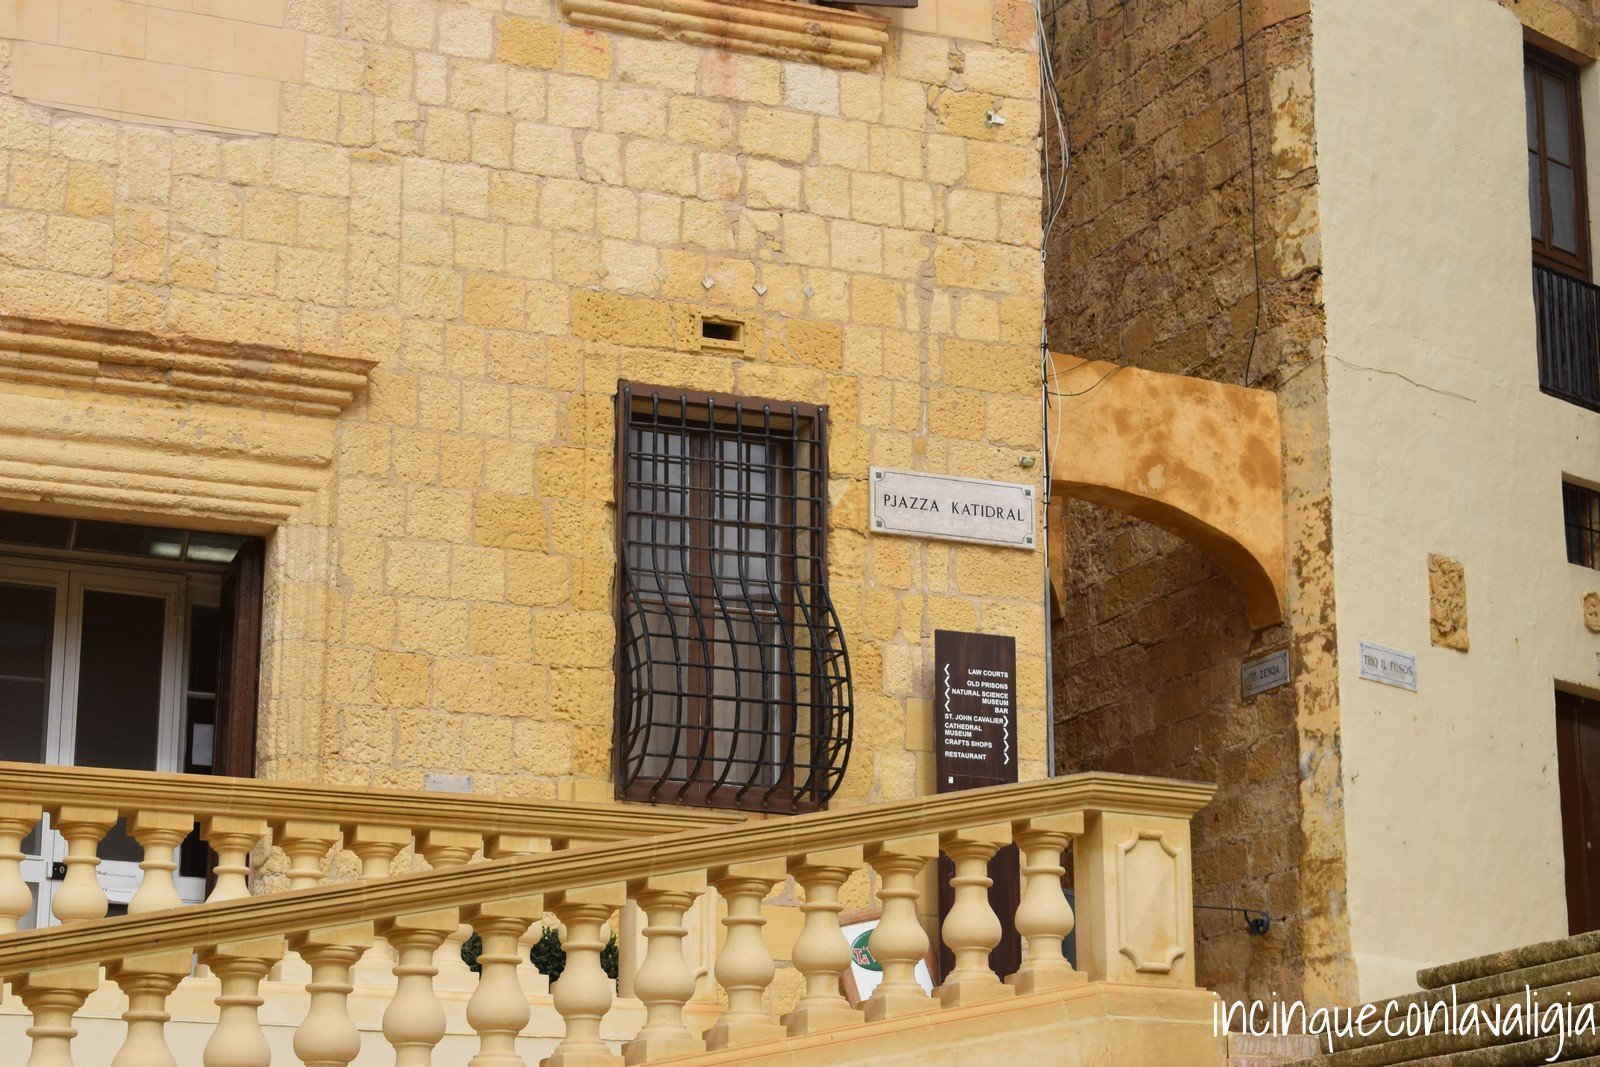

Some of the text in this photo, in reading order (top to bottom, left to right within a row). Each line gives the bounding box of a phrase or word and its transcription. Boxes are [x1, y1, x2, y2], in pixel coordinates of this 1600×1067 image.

[883, 494, 1024, 522] PJAZZA KATIDRAL
[983, 670, 1009, 678] COURTS
[981, 682, 1009, 690] PRISONS
[952, 688, 1009, 699] NATURAL SCIENCE
[982, 698, 1009, 706] MUSEUM
[955, 714, 973, 722] JOHN
[973, 715, 1004, 724] CAVALIER
[944, 722, 983, 731] CATHEDRAL
[944, 729, 972, 737] MUSEUM
[944, 738, 970, 746] CRAFTS
[944, 751, 987, 760] RESTAURANT
